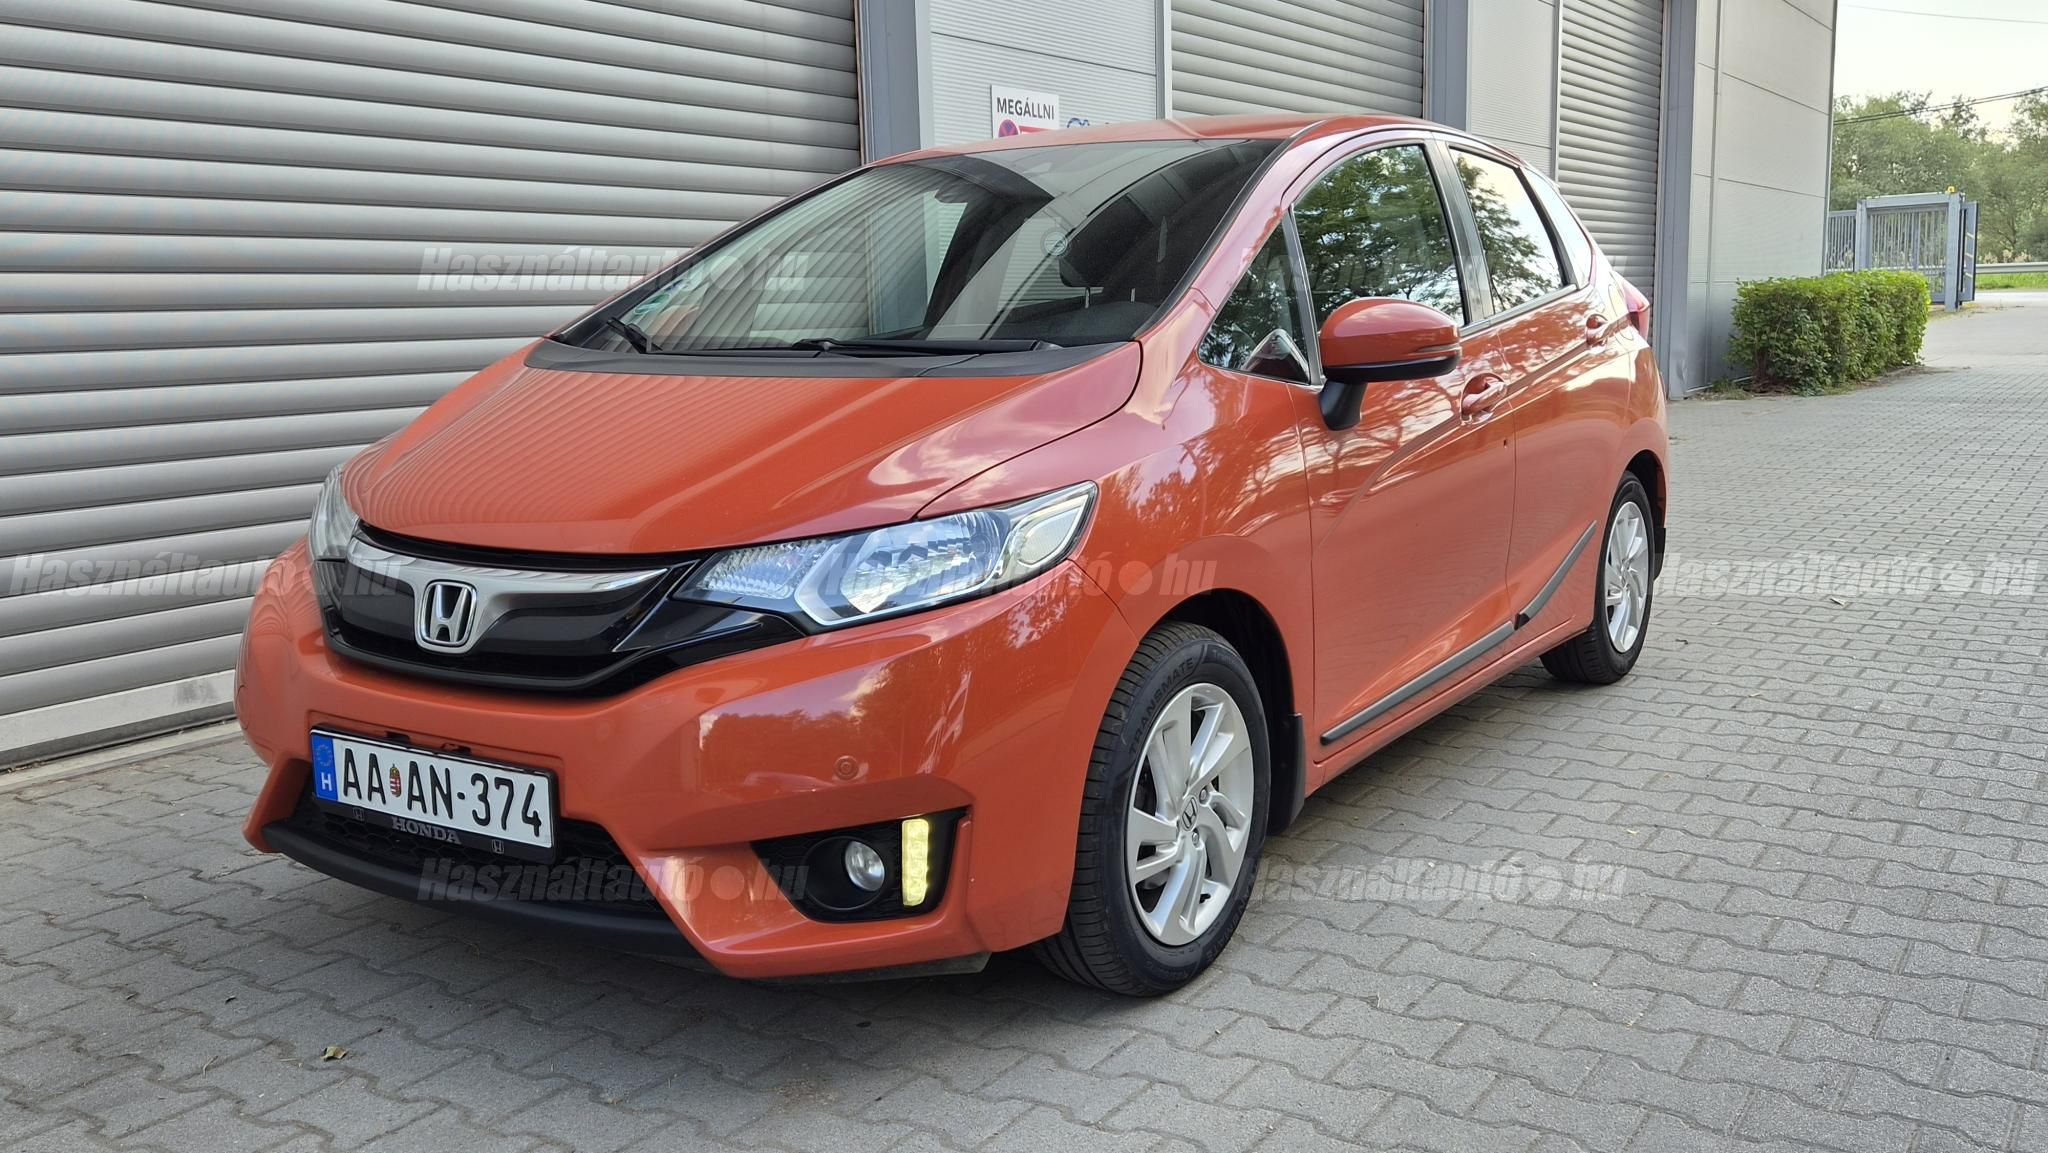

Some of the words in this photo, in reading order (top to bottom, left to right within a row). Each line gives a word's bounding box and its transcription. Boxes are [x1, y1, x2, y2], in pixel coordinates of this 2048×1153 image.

[996, 96, 1055, 120] MEGÁLLNI
[1128, 657, 1195, 757] TRANSMATE
[320, 771, 333, 792] H
[392, 816, 462, 845] HONDA
